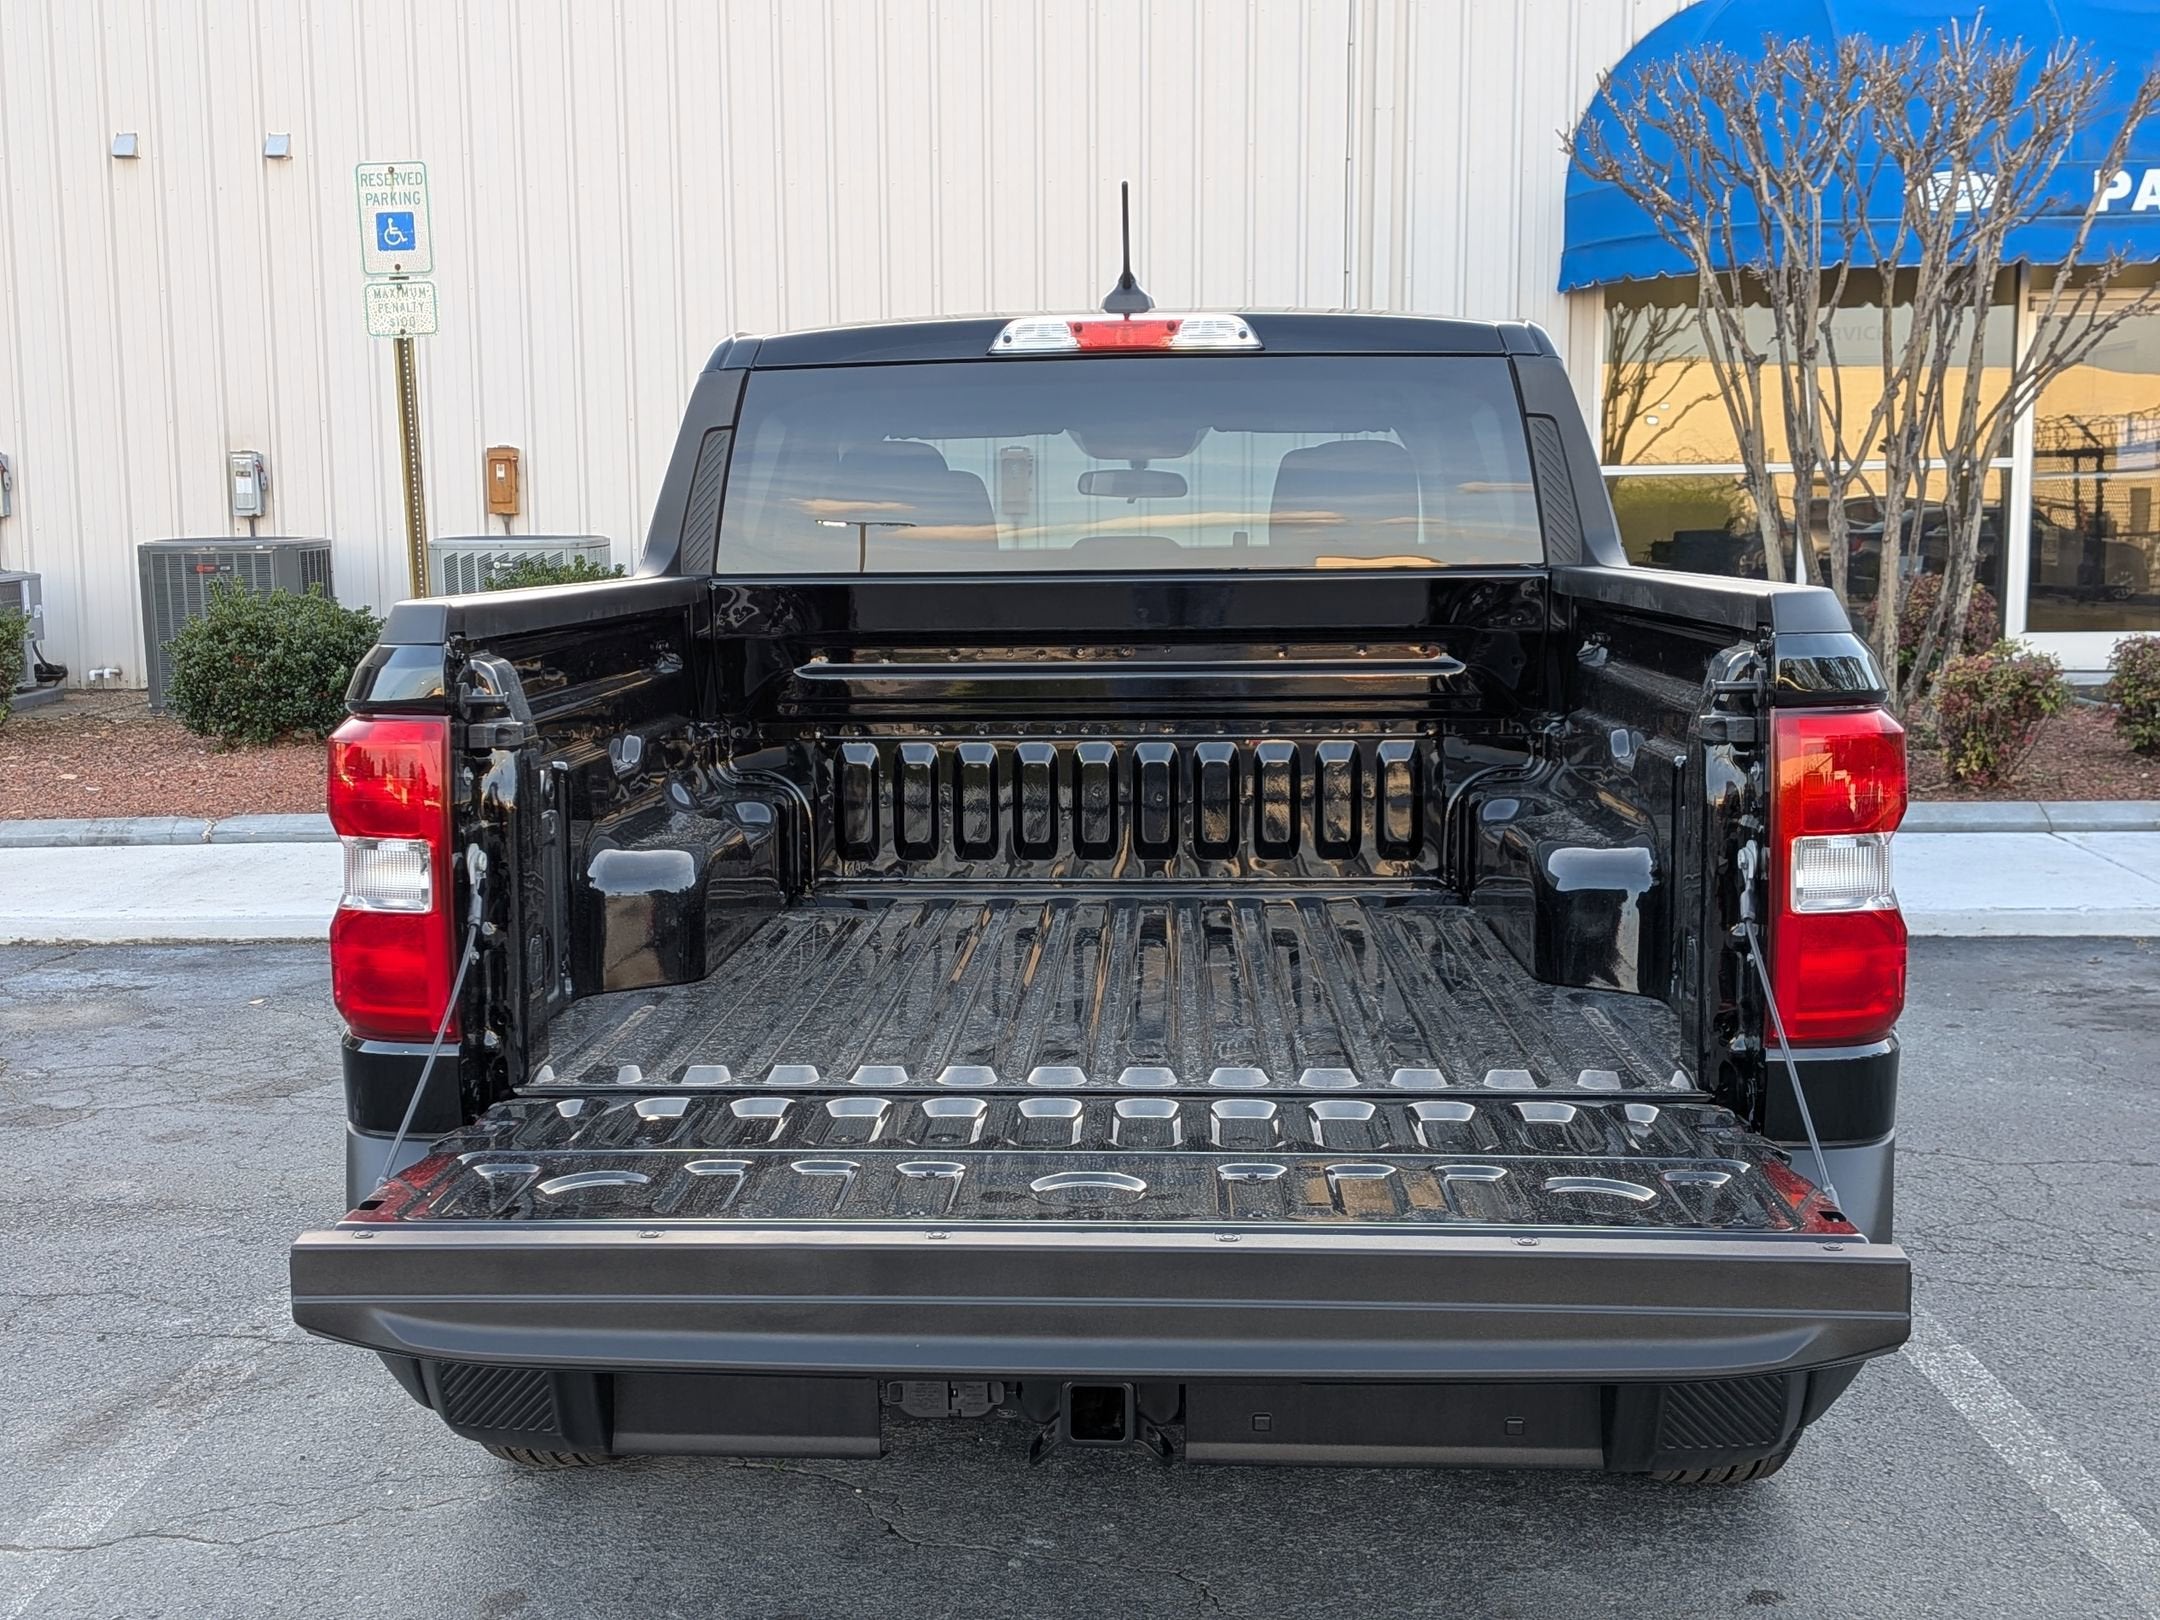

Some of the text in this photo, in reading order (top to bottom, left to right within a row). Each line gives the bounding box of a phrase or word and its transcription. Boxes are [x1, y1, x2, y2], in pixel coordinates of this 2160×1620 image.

[360, 171, 423, 187] RESERVED
[365, 191, 421, 206] PARKING
[373, 287, 427, 299] MAXIMUM
[378, 302, 424, 313] PENALTY
